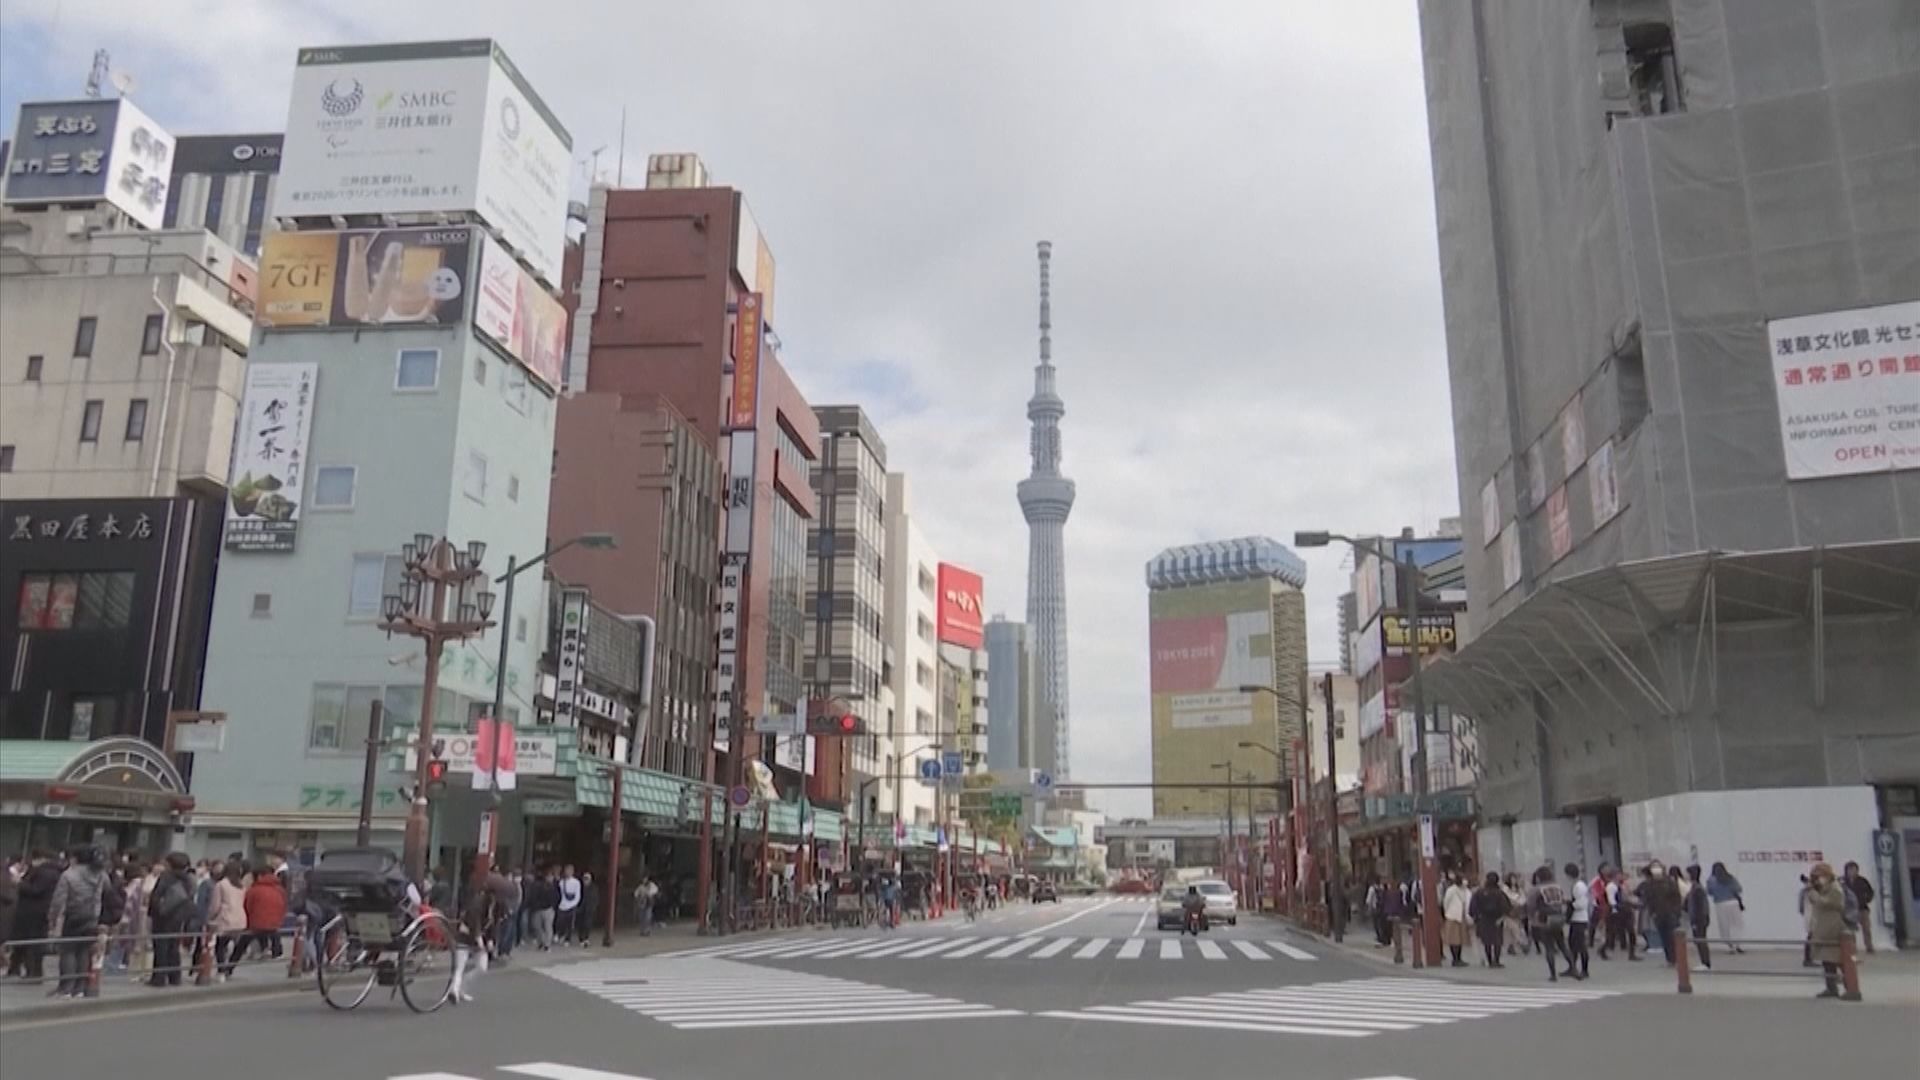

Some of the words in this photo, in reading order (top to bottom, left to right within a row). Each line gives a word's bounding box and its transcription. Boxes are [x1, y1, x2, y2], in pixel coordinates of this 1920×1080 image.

[400, 90, 457, 107] SMBC
[34, 115, 97, 137] 天ぷら
[376, 114, 453, 130] 三井住友銀行
[270, 263, 329, 289] 7GF
[1787, 411, 1848, 426] ASAKUSA
[1789, 423, 1877, 441] INFORMATION
[1834, 444, 1887, 462] OPEN
[9, 513, 152, 541] 黒田屋本店
